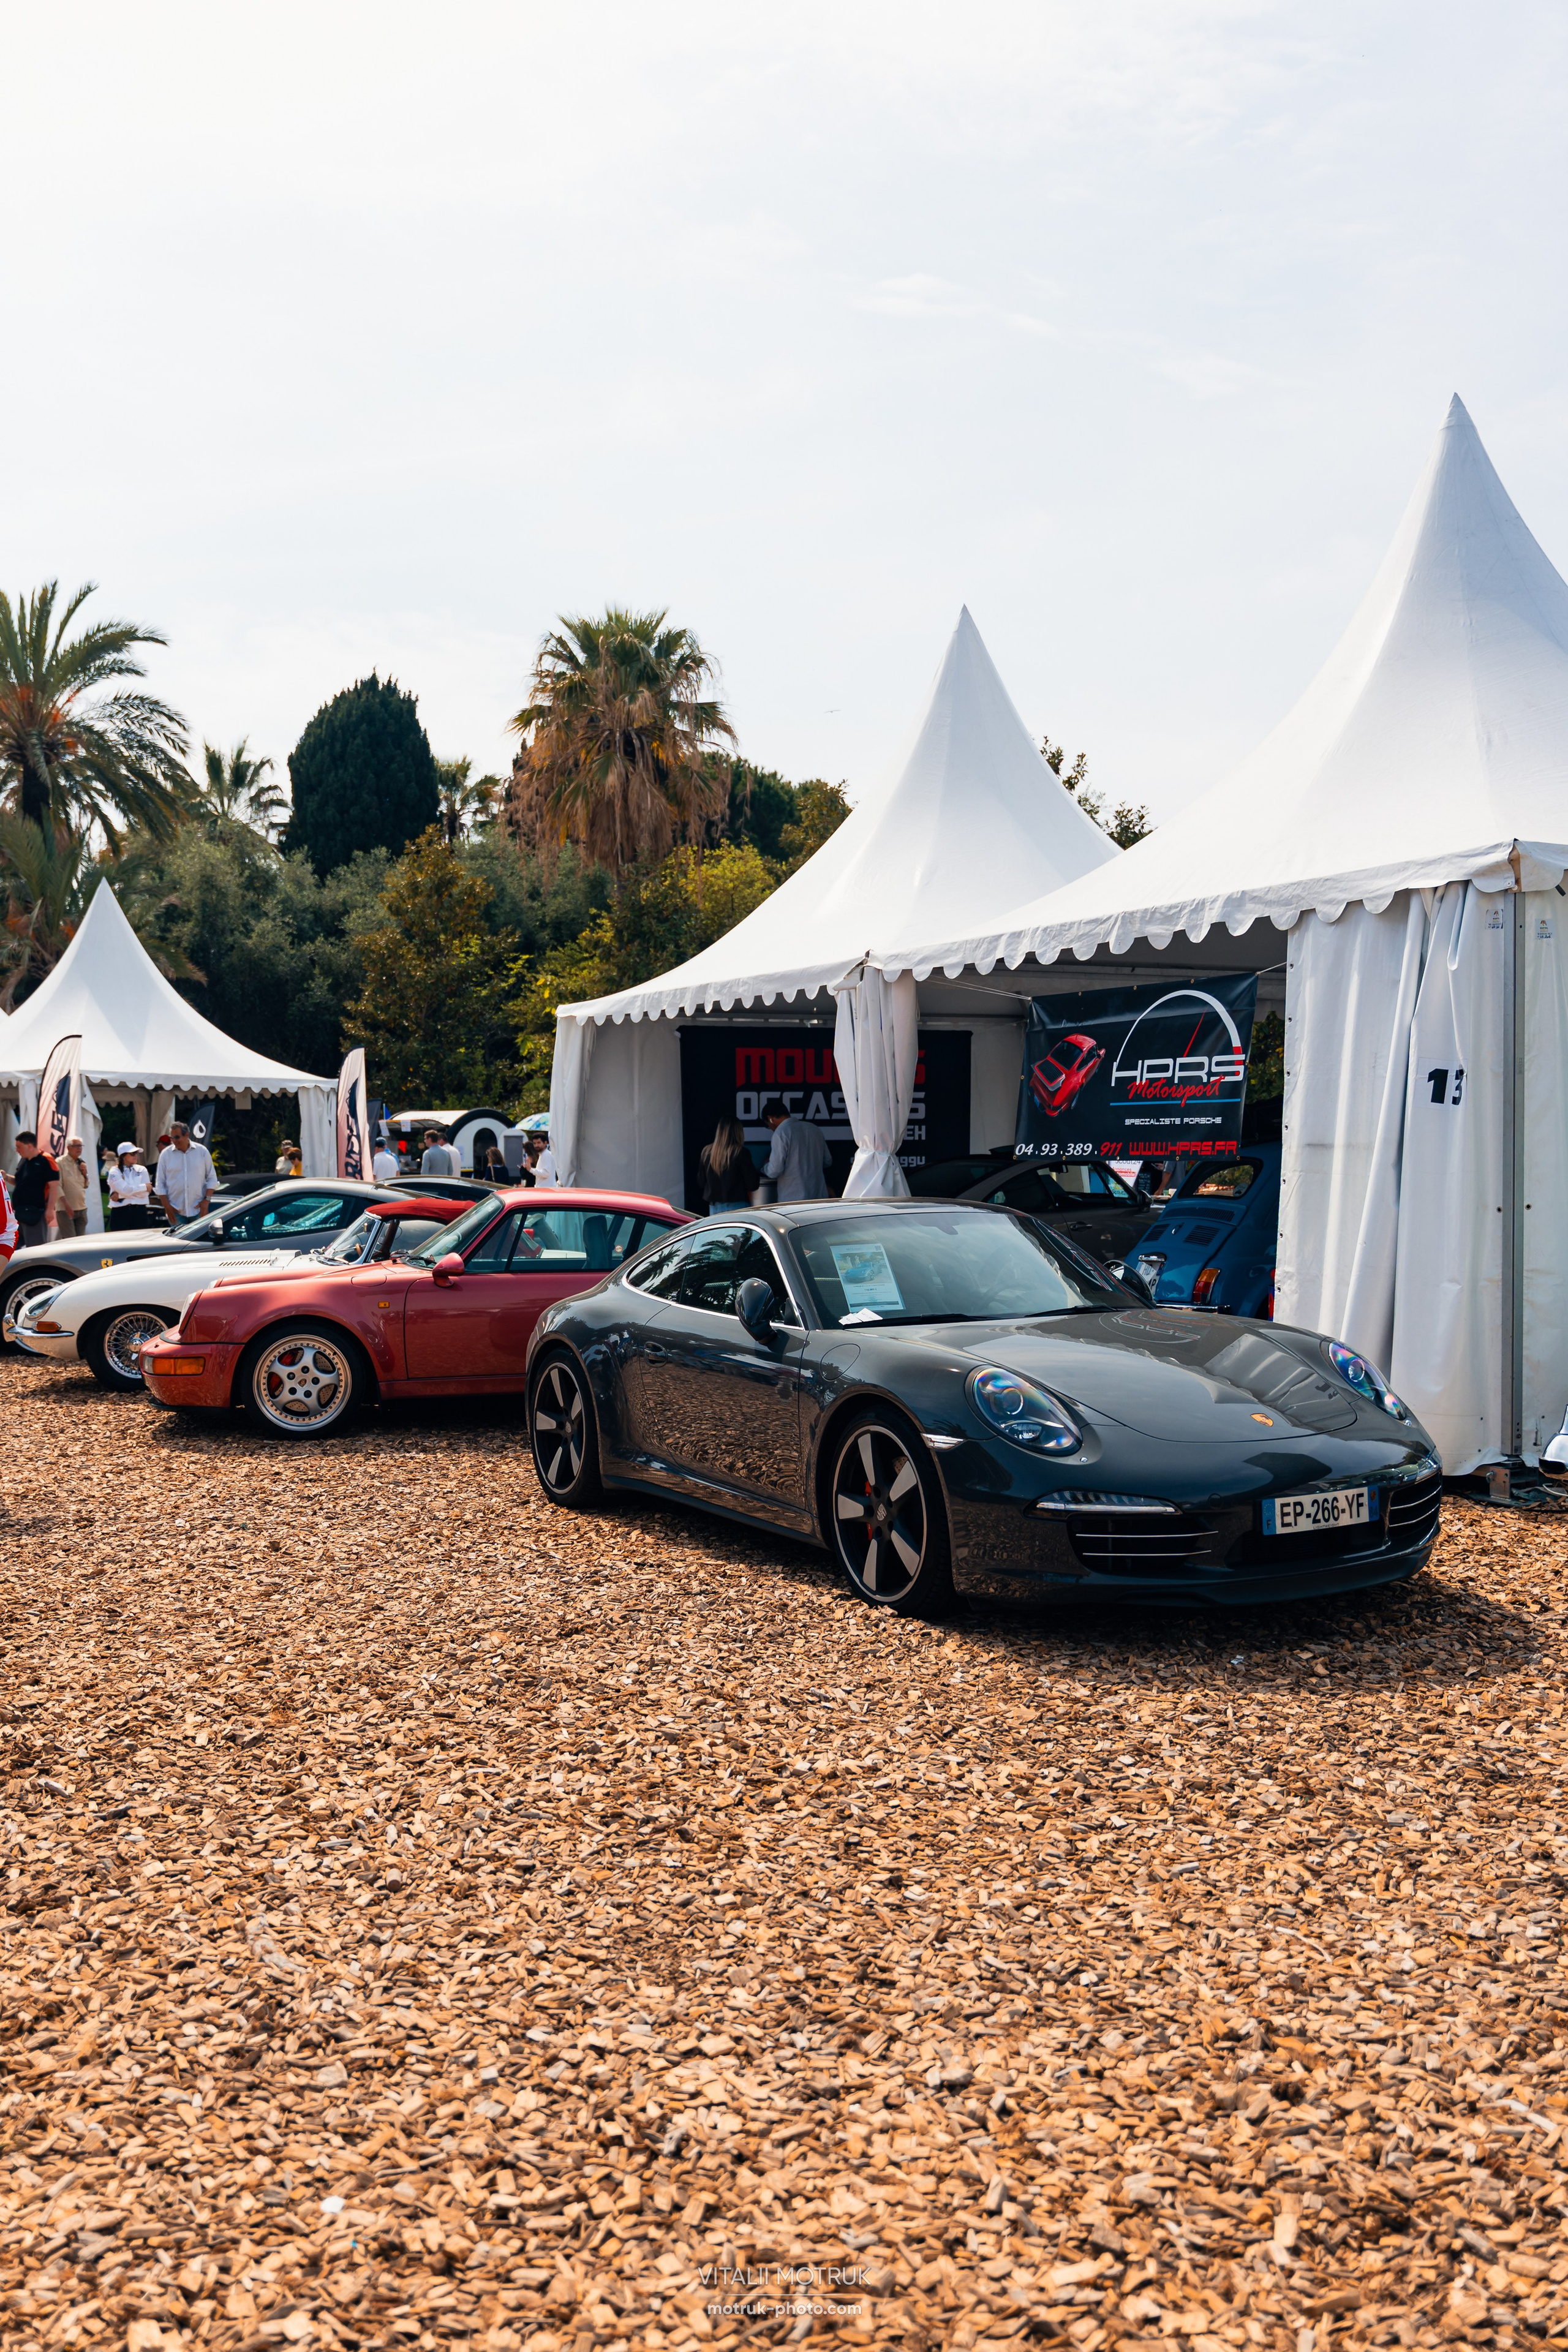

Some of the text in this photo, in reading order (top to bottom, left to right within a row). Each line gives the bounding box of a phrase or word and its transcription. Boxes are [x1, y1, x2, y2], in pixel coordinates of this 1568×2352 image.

[1111, 1054, 1245, 1087] HPRS
[1427, 1068, 1464, 1106] 13
[1127, 1075, 1226, 1107] Motorsport
[1129, 1141, 1237, 1156] WWW.HPRS.FR
[1266, 1519, 1272, 1530] F
[1280, 1493, 1364, 1528] EP-266-YF
